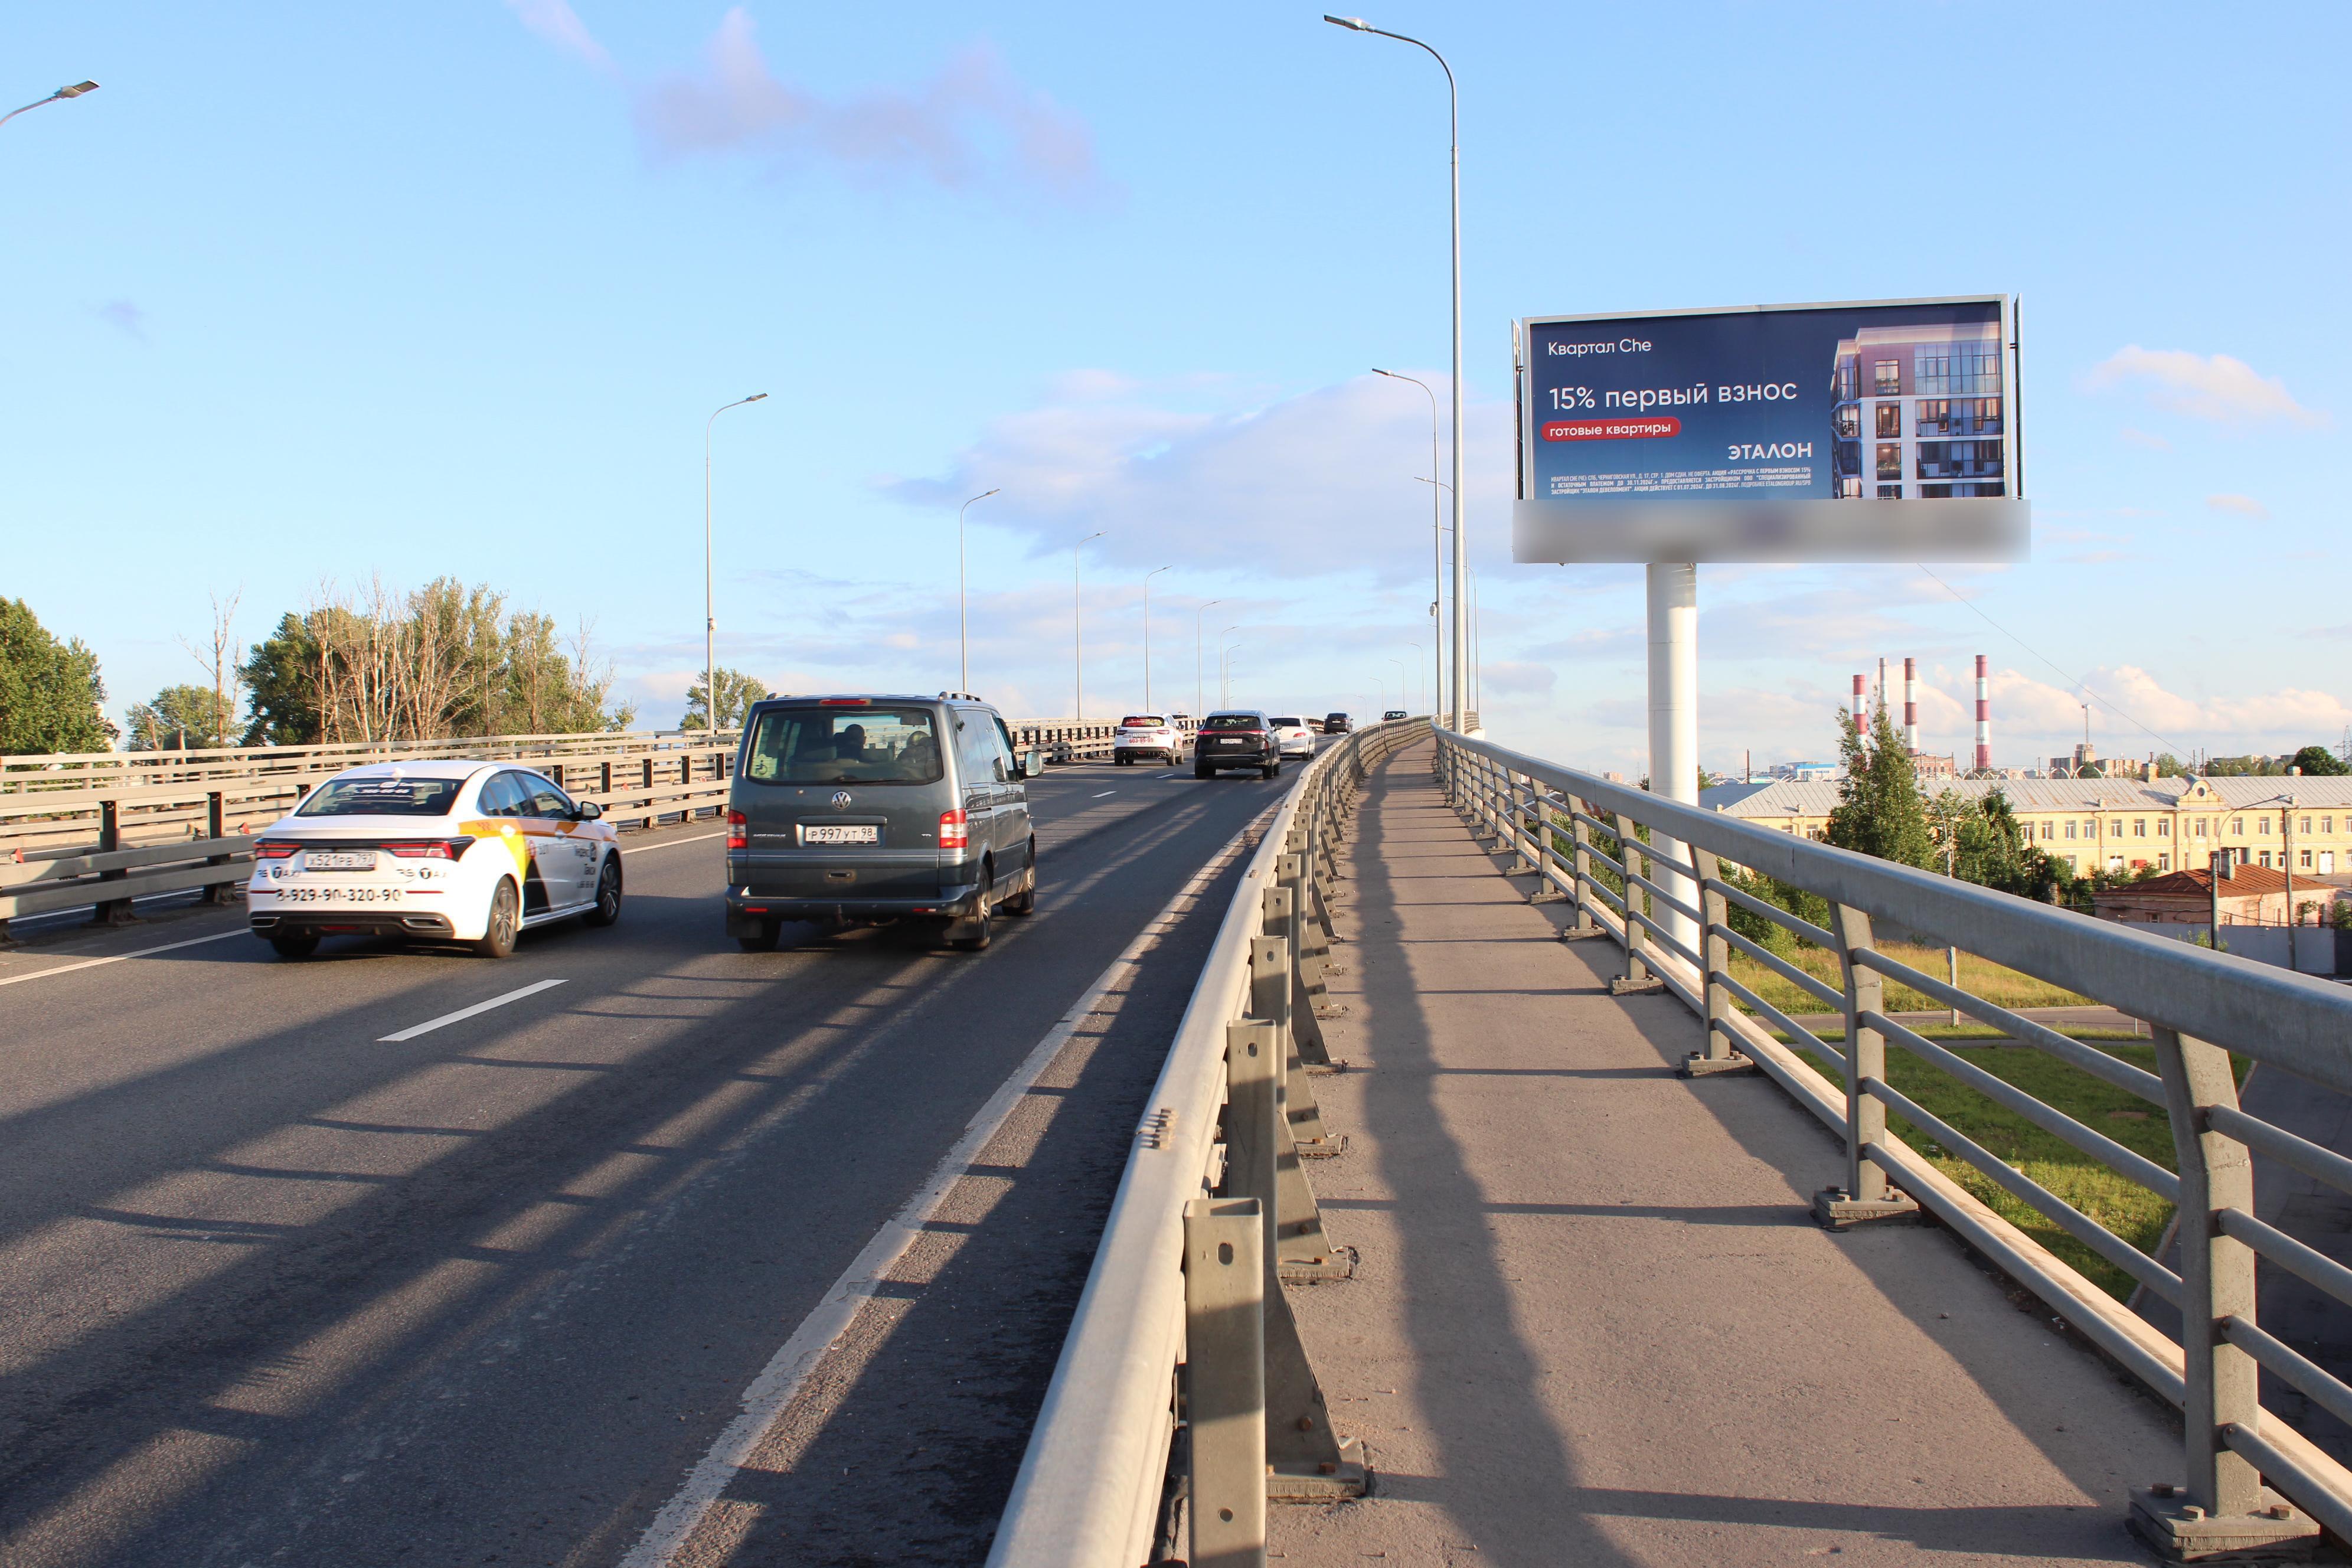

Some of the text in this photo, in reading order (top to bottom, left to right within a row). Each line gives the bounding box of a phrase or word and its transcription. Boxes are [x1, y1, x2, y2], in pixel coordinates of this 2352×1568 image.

[1549, 339, 1651, 357] Квартал Che
[1549, 383, 1798, 412] 15% первый взнос
[1550, 422, 1671, 437] готовые квартиры
[1728, 442, 1811, 460] ЭТАЛОН
[811, 828, 873, 839] Р997УТ 98
[276, 888, 401, 901] 8-929-90-320-90
